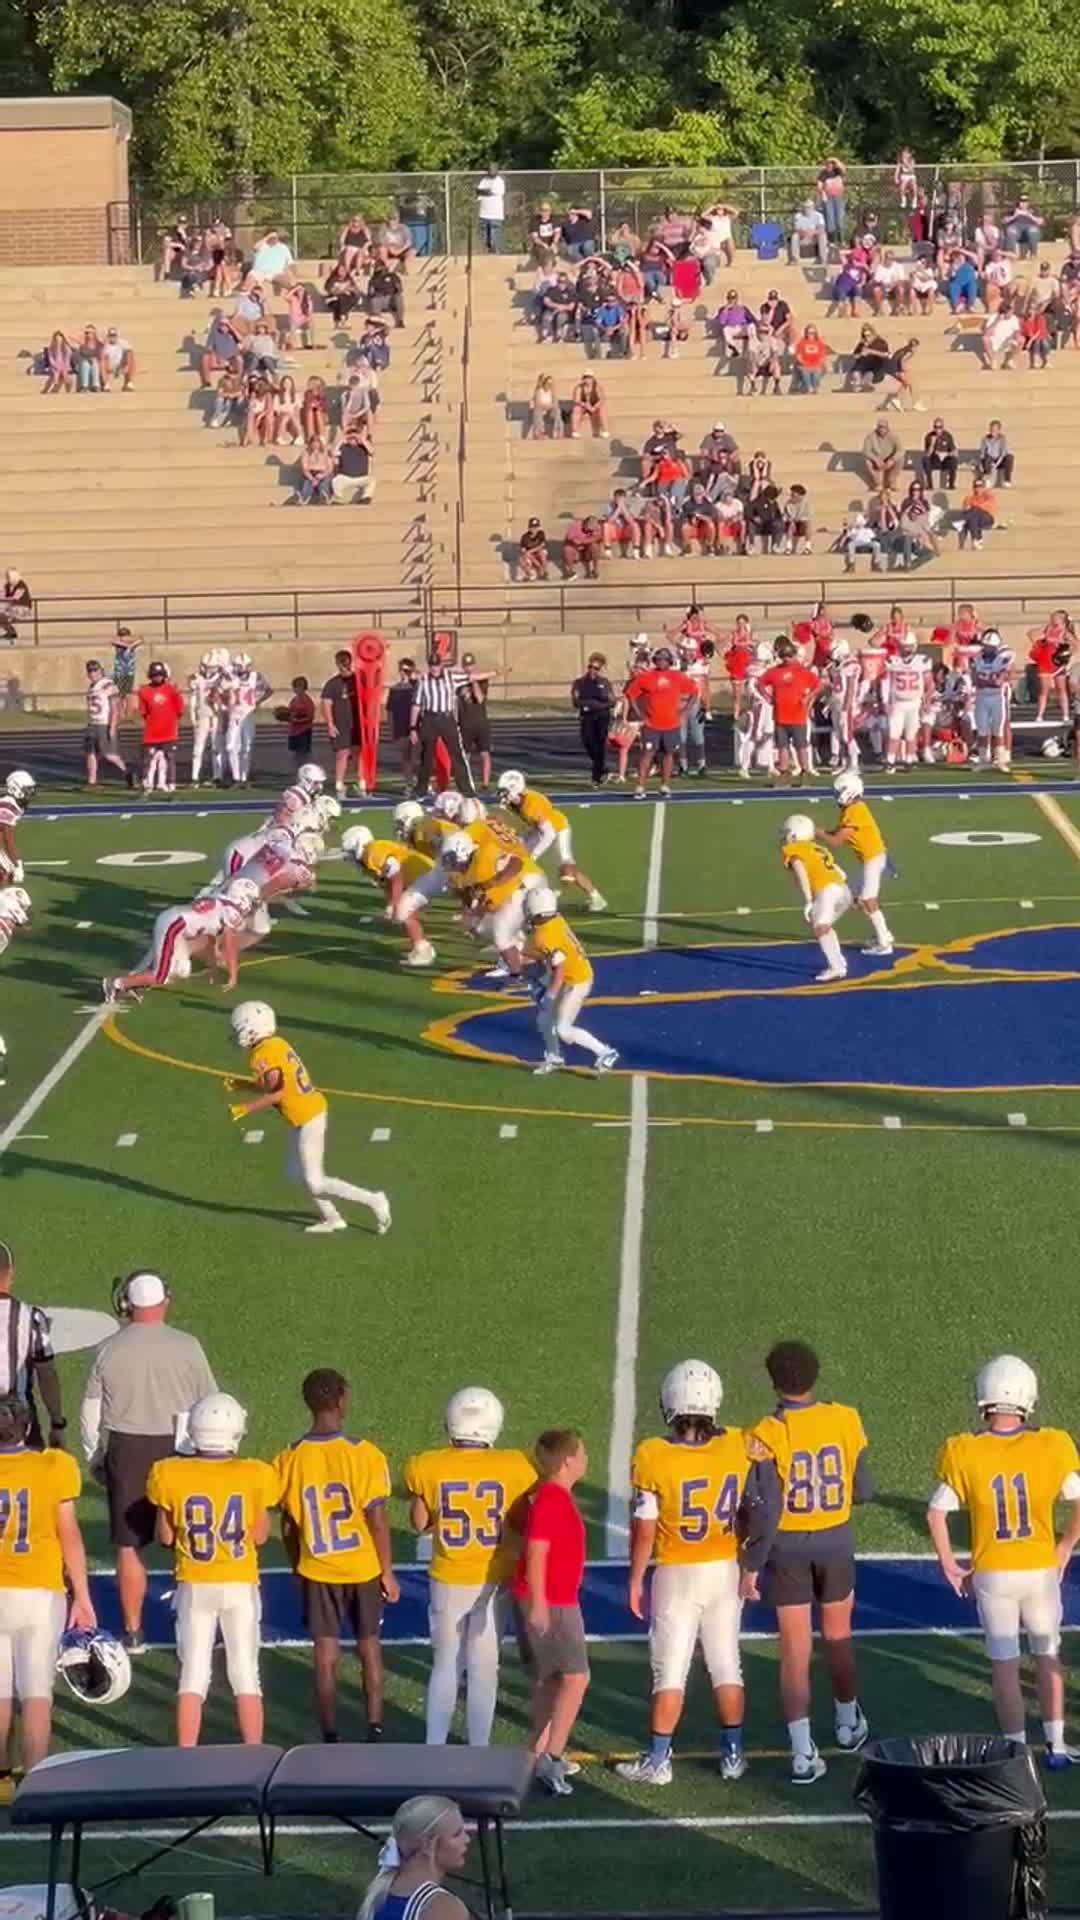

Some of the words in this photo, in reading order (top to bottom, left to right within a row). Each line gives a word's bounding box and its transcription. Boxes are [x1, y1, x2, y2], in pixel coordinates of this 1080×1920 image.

[895, 671, 920, 690] 52
[680, 1474, 737, 1542] 54
[787, 1446, 843, 1513] 88
[992, 1473, 1031, 1540] 11
[185, 1495, 244, 1562] 84
[302, 1482, 358, 1556] 12
[440, 1481, 504, 1547] 53
